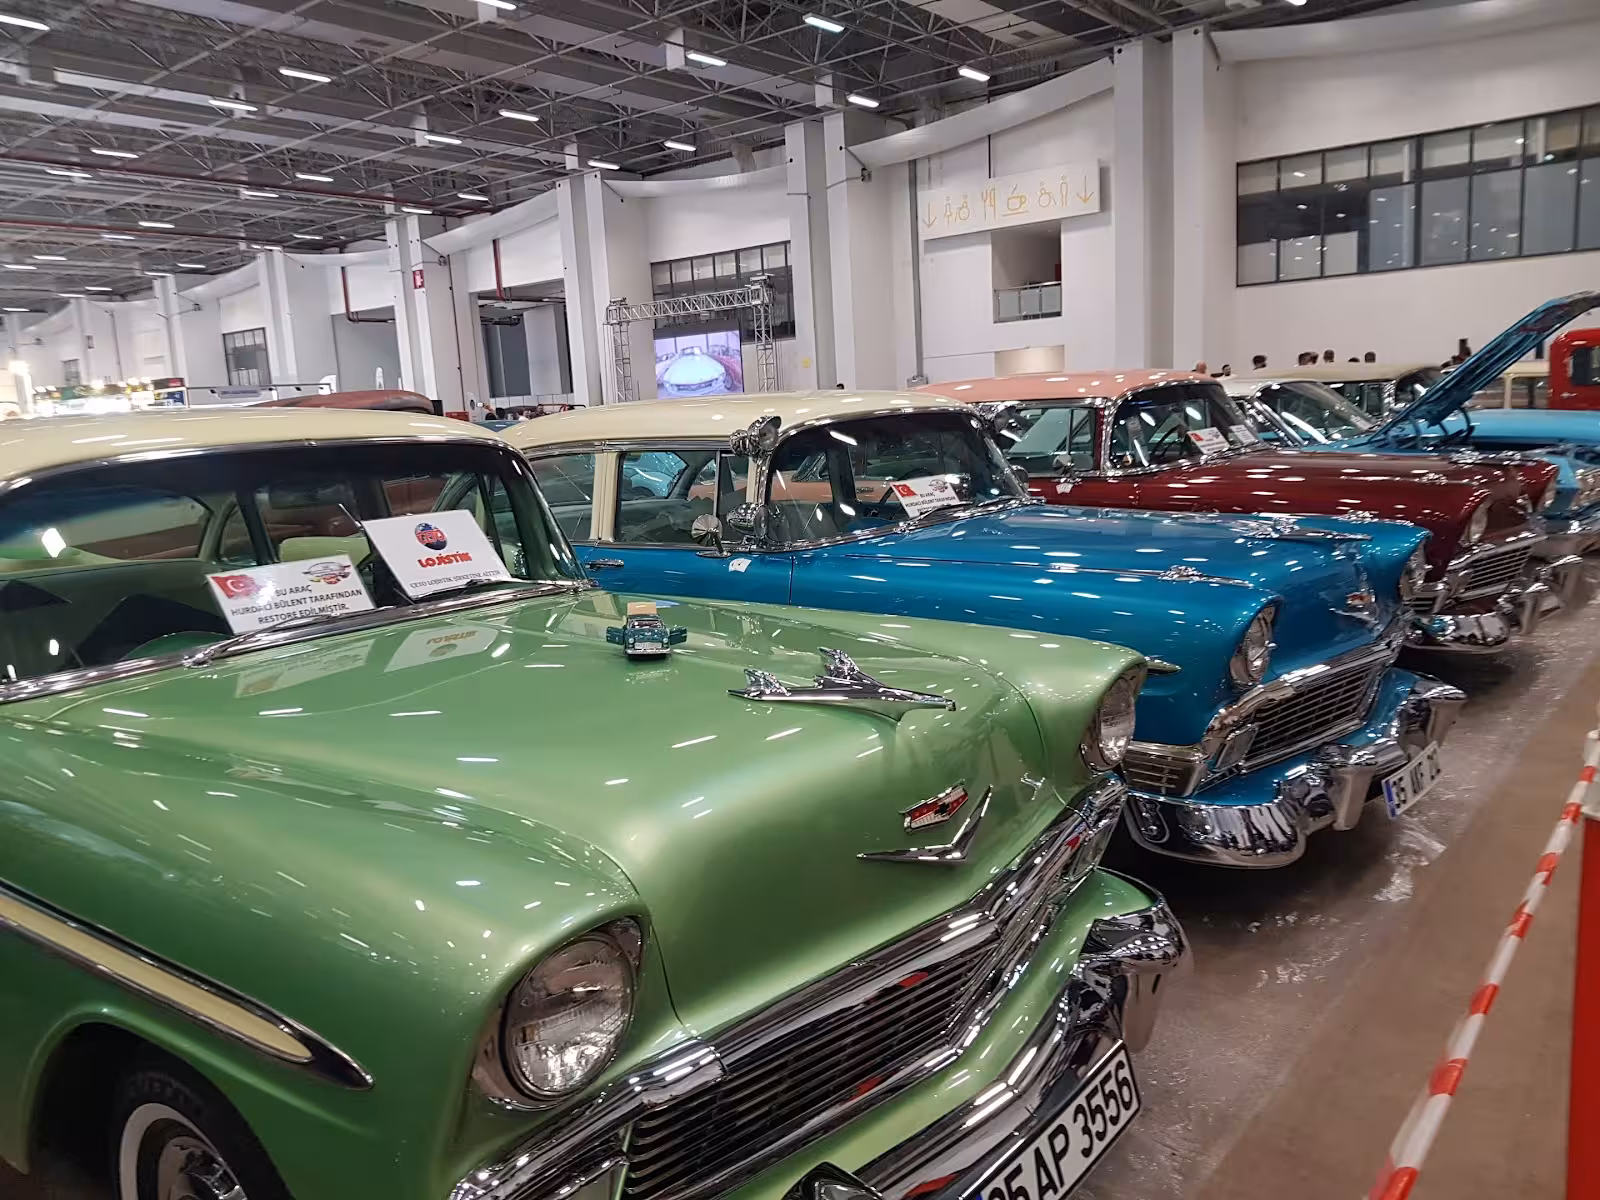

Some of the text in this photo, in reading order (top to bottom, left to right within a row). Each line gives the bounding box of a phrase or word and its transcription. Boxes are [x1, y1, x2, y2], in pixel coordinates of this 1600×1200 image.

[273, 596, 308, 610] BÜLENT
[308, 588, 363, 604] TARAFINDAN
[275, 584, 312, 597] BU ARAÇ
[257, 610, 298, 624] RESTORE
[988, 1060, 1133, 1200] 5 AP 3556
